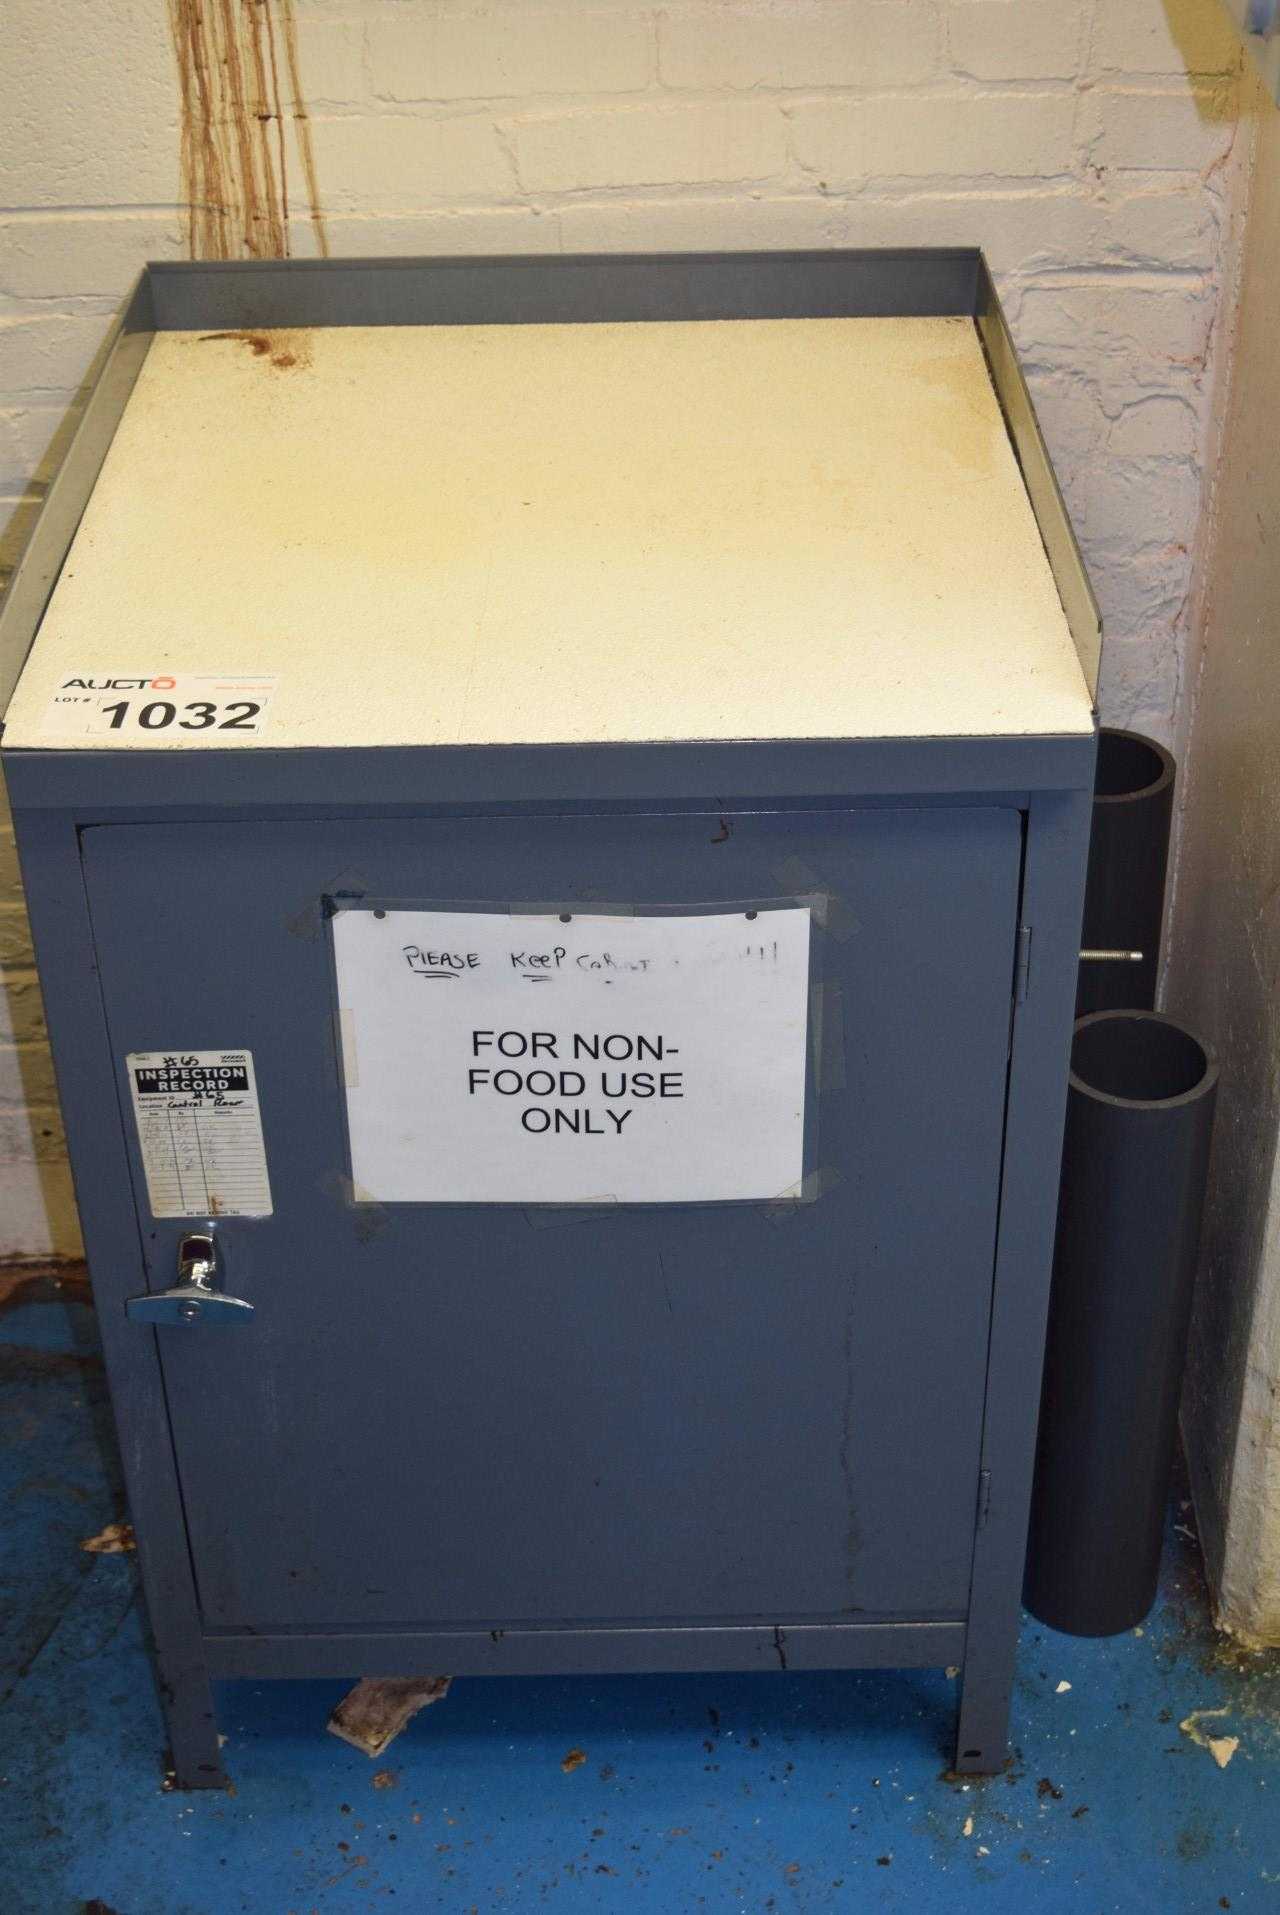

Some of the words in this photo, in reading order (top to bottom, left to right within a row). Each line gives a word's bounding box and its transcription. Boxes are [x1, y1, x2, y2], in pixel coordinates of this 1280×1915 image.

[102, 701, 261, 730] 1032
[472, 1030, 560, 1059] FOR
[573, 1033, 680, 1061] NON-
[138, 1067, 245, 1080] INSPECTION
[158, 1079, 229, 1092] RECORD
[468, 1069, 586, 1097] FOOD
[601, 1072, 684, 1098] USE
[521, 1107, 633, 1134] ONLY
